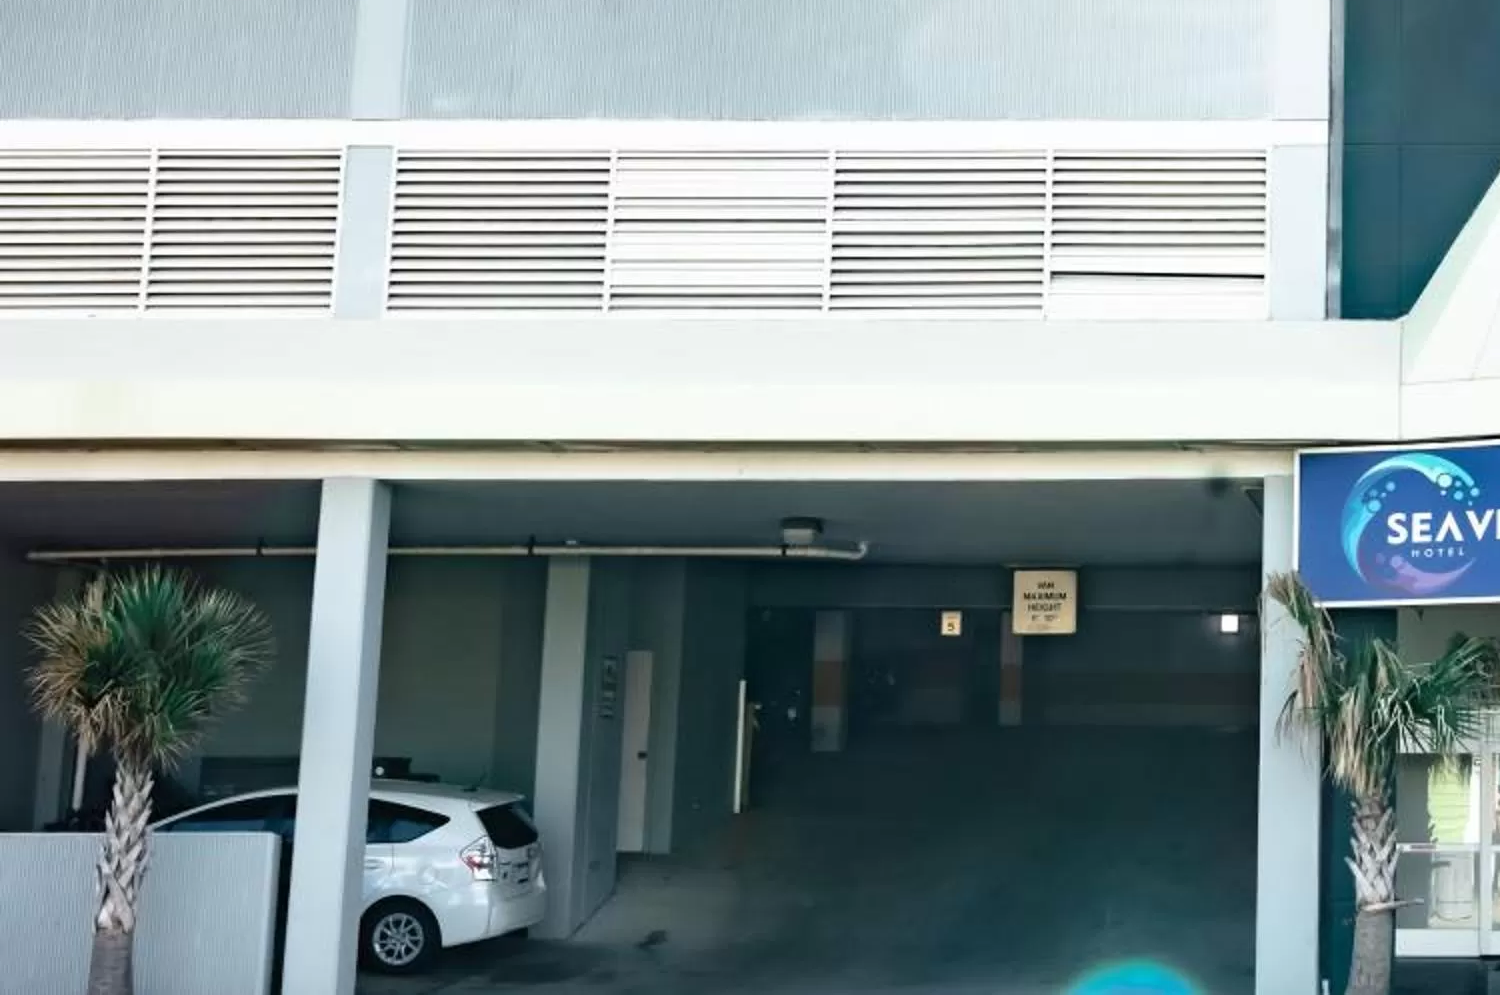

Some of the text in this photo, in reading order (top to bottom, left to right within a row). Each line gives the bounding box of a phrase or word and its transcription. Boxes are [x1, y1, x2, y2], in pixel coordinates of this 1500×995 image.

[1411, 547, 1465, 558] HOTEL
[1023, 592, 1067, 600] MAXIMUM
[1027, 602, 1063, 612] HEIGHT
